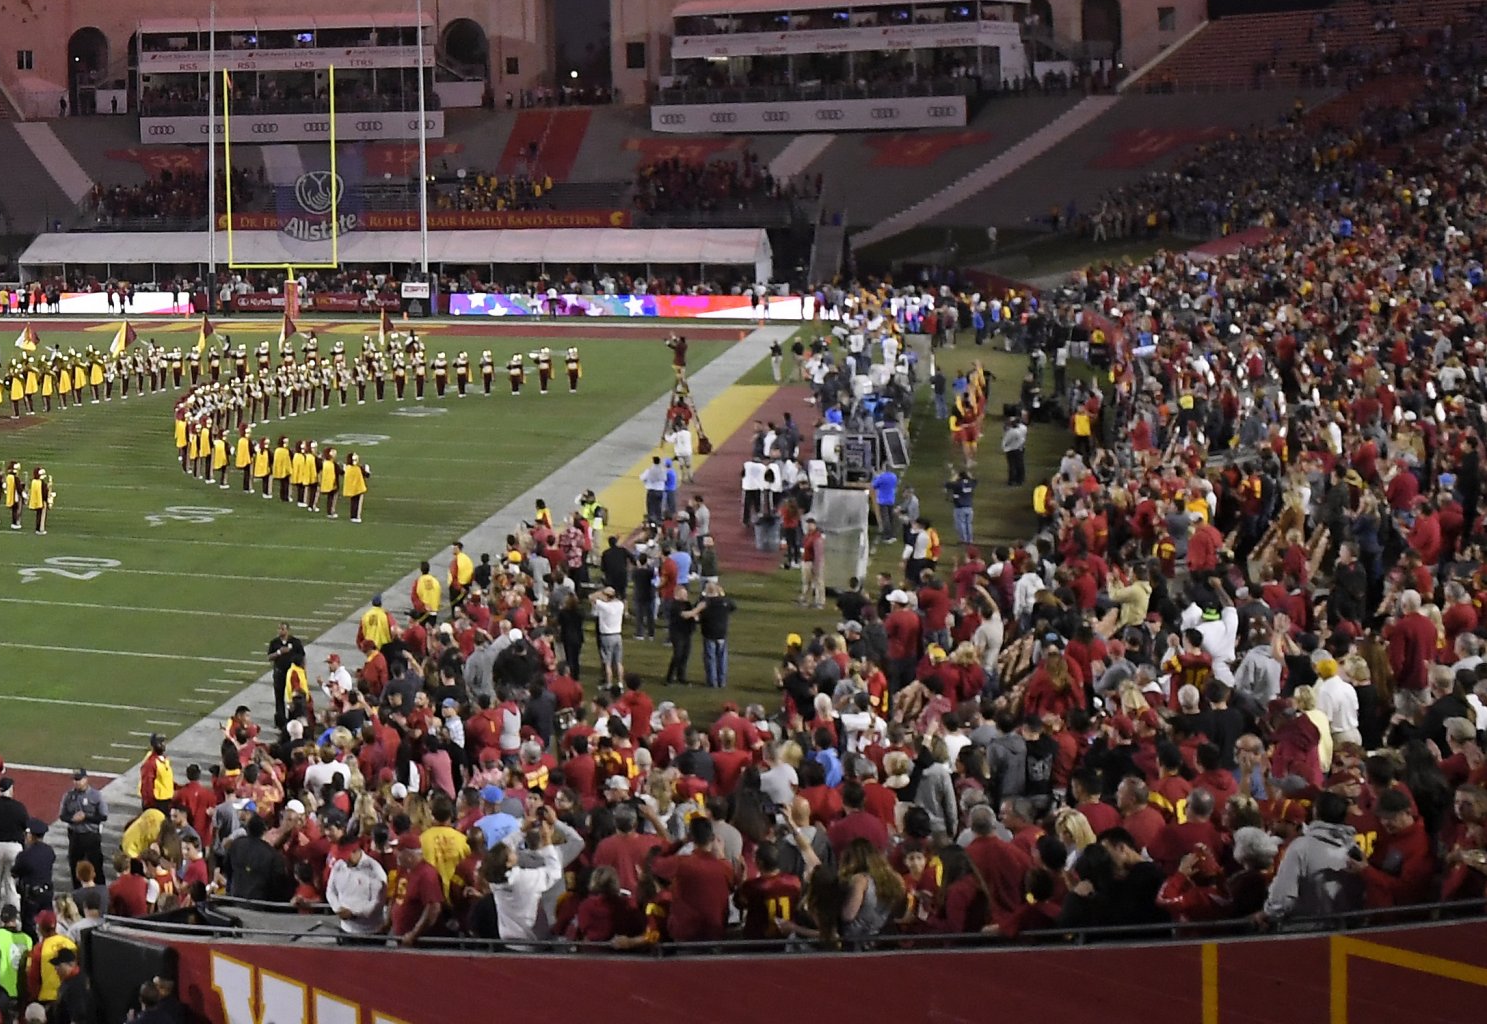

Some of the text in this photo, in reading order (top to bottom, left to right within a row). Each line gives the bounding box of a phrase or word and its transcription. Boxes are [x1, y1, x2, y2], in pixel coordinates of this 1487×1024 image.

[461, 215, 502, 226] FAMILY
[507, 215, 543, 226] BAND
[546, 214, 601, 225] SECTION
[144, 505, 234, 527] 30
[18, 556, 122, 584] 20
